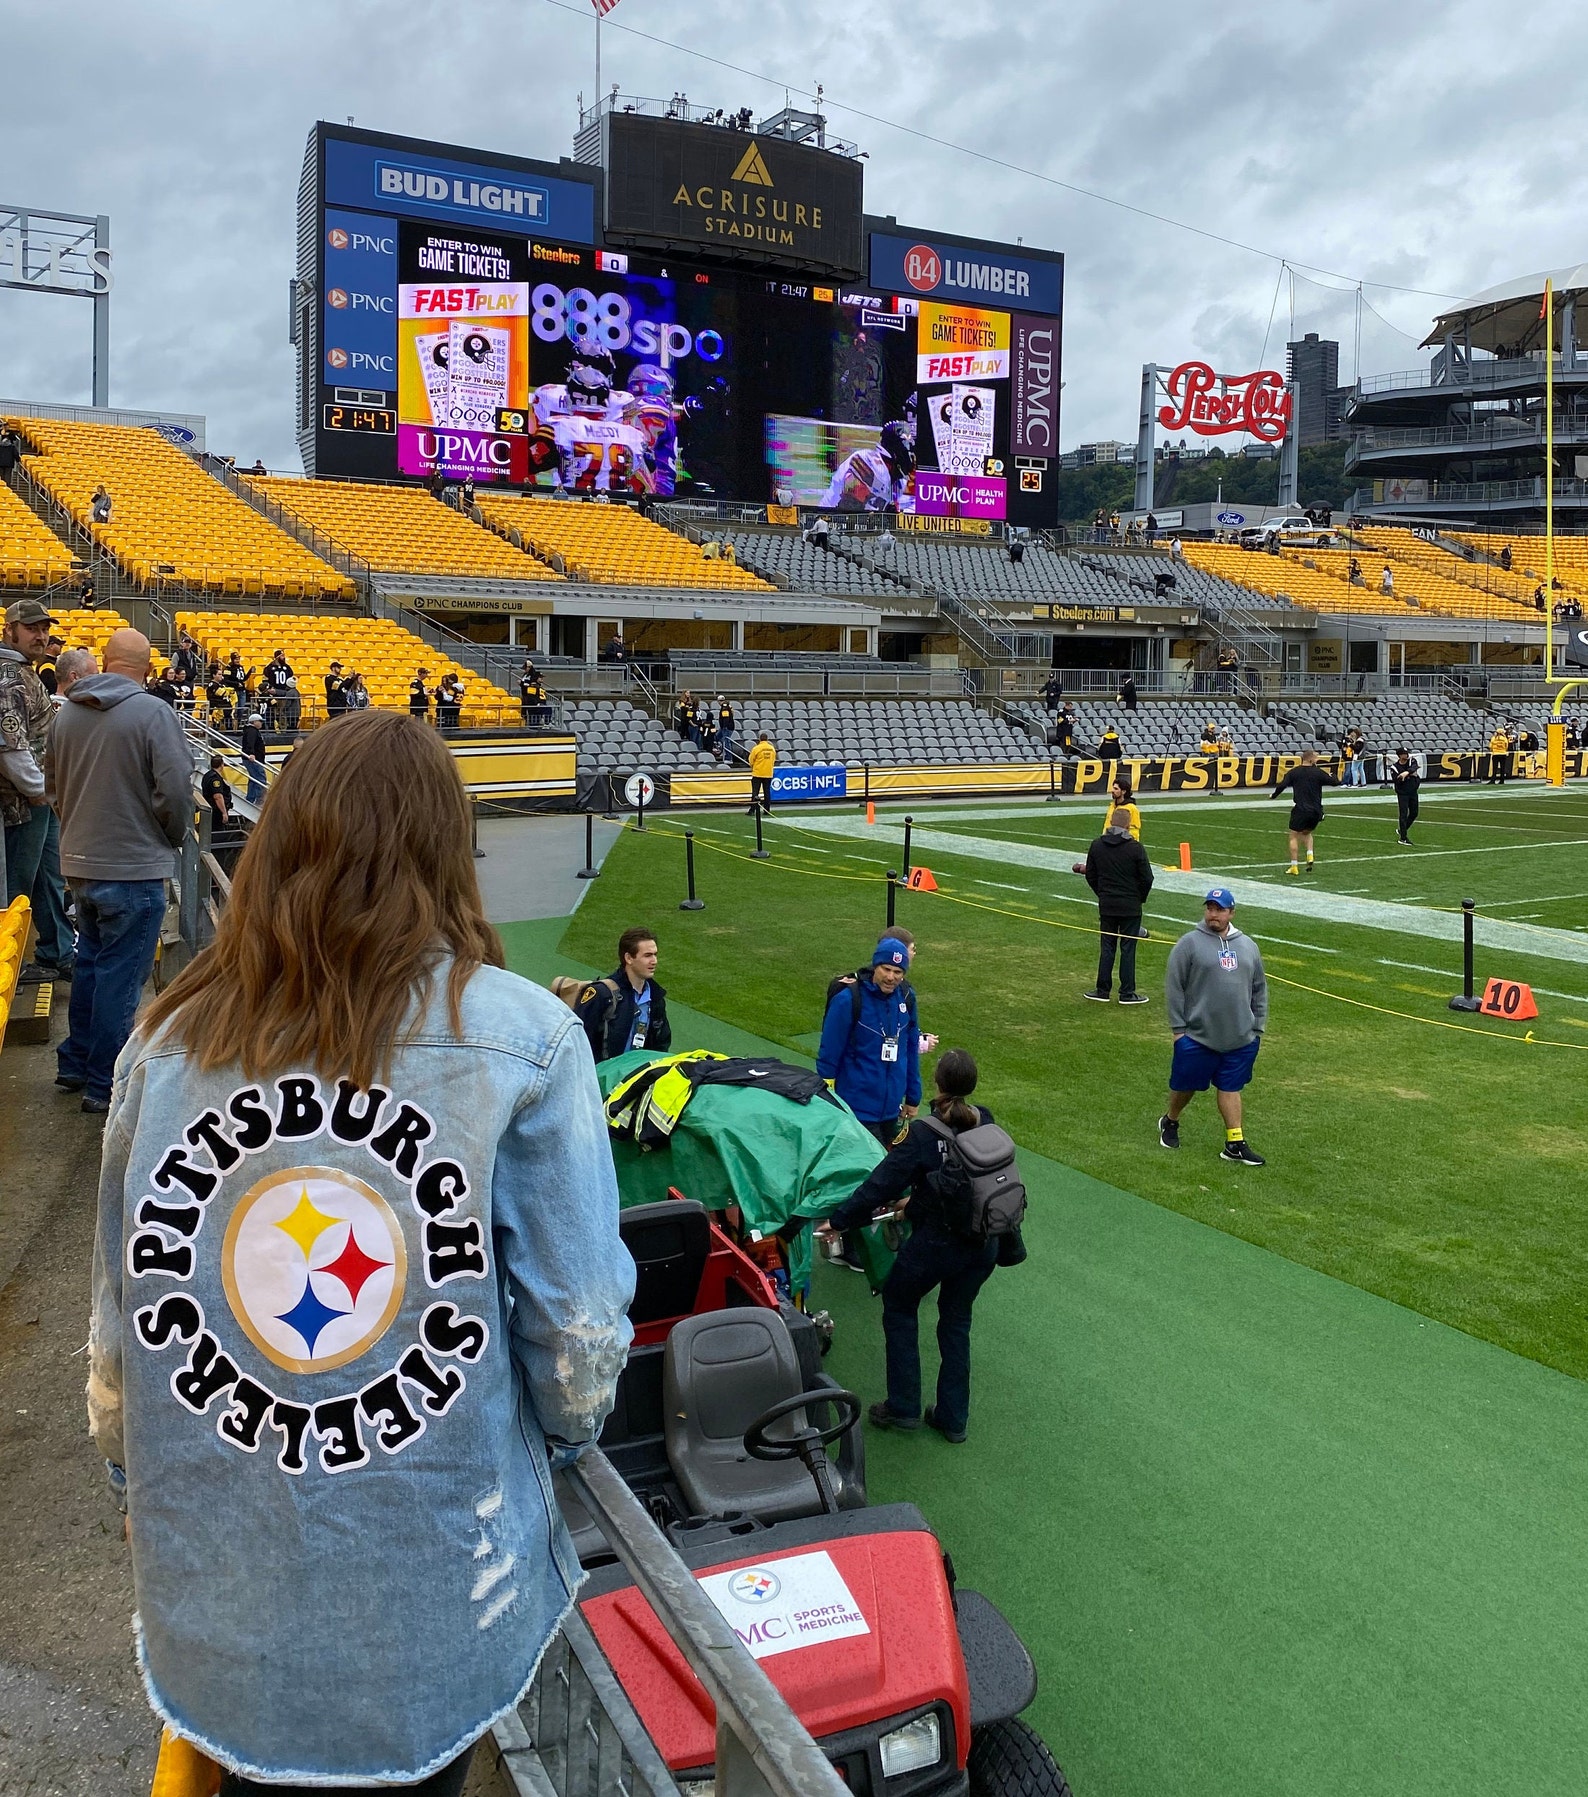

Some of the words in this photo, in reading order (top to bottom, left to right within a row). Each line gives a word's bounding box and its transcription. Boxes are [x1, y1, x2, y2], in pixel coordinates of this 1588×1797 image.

[381, 168, 448, 200] BUD
[453, 180, 543, 216] LIGHT
[672, 183, 822, 229] ACRISURE
[705, 216, 794, 246] STADIUM
[351, 233, 394, 255] PNC
[427, 237, 462, 251] ENTER
[463, 242, 478, 253] TO
[480, 244, 501, 257] WIN
[418, 247, 454, 272] GAME
[457, 253, 510, 280] TICKETS!
[532, 244, 580, 265] Steelers
[610, 259, 619, 271] 0
[908, 253, 936, 283] 84
[944, 259, 1030, 297] LUMBER
[660, 268, 668, 278] &
[695, 273, 709, 284] ON
[781, 284, 808, 297] 21:47
[350, 292, 393, 313] PNC
[842, 294, 883, 308] JETS
[904, 303, 912, 314] 0
[938, 314, 962, 325] ENTER
[965, 317, 974, 327] TO
[976, 319, 991, 328] WIN
[932, 323, 956, 343] GAME
[959, 327, 996, 348] TICKETS!
[350, 352, 393, 372] PNC
[1026, 329, 1053, 447] UPMC
[330, 408, 390, 430] 21:47
[1016, 400, 1024, 445] MEDICINE
[416, 432, 512, 465] UPMC
[418, 461, 435, 469] LIFE
[436, 462, 475, 472] CHANGING
[476, 466, 511, 475] MEDICINE
[1022, 473, 1039, 489] 25
[918, 484, 970, 504] UPMC
[975, 488, 1004, 498] HEALTH
[975, 496, 995, 506] PLAN
[898, 515, 920, 530] LIVE
[1411, 527, 1437, 541] FAN
[427, 599, 449, 608] PNC
[451, 600, 500, 610] CHAMPIONS
[502, 602, 523, 610] CLUB
[1052, 604, 1116, 622] Steelers.com
[274, 671, 286, 685] 10
[782, 776, 808, 790] CBS
[815, 775, 840, 788] NFL
[1221, 957, 1236, 969] NFL
[1486, 982, 1521, 1014] 10
[129, 1075, 487, 1286] PITTSBURGH
[135, 1294, 488, 1472] STEELERS
[793, 1604, 846, 1621] SPORTS
[798, 1612, 863, 1632] MEDICINE
[733, 1617, 787, 1646] MC
